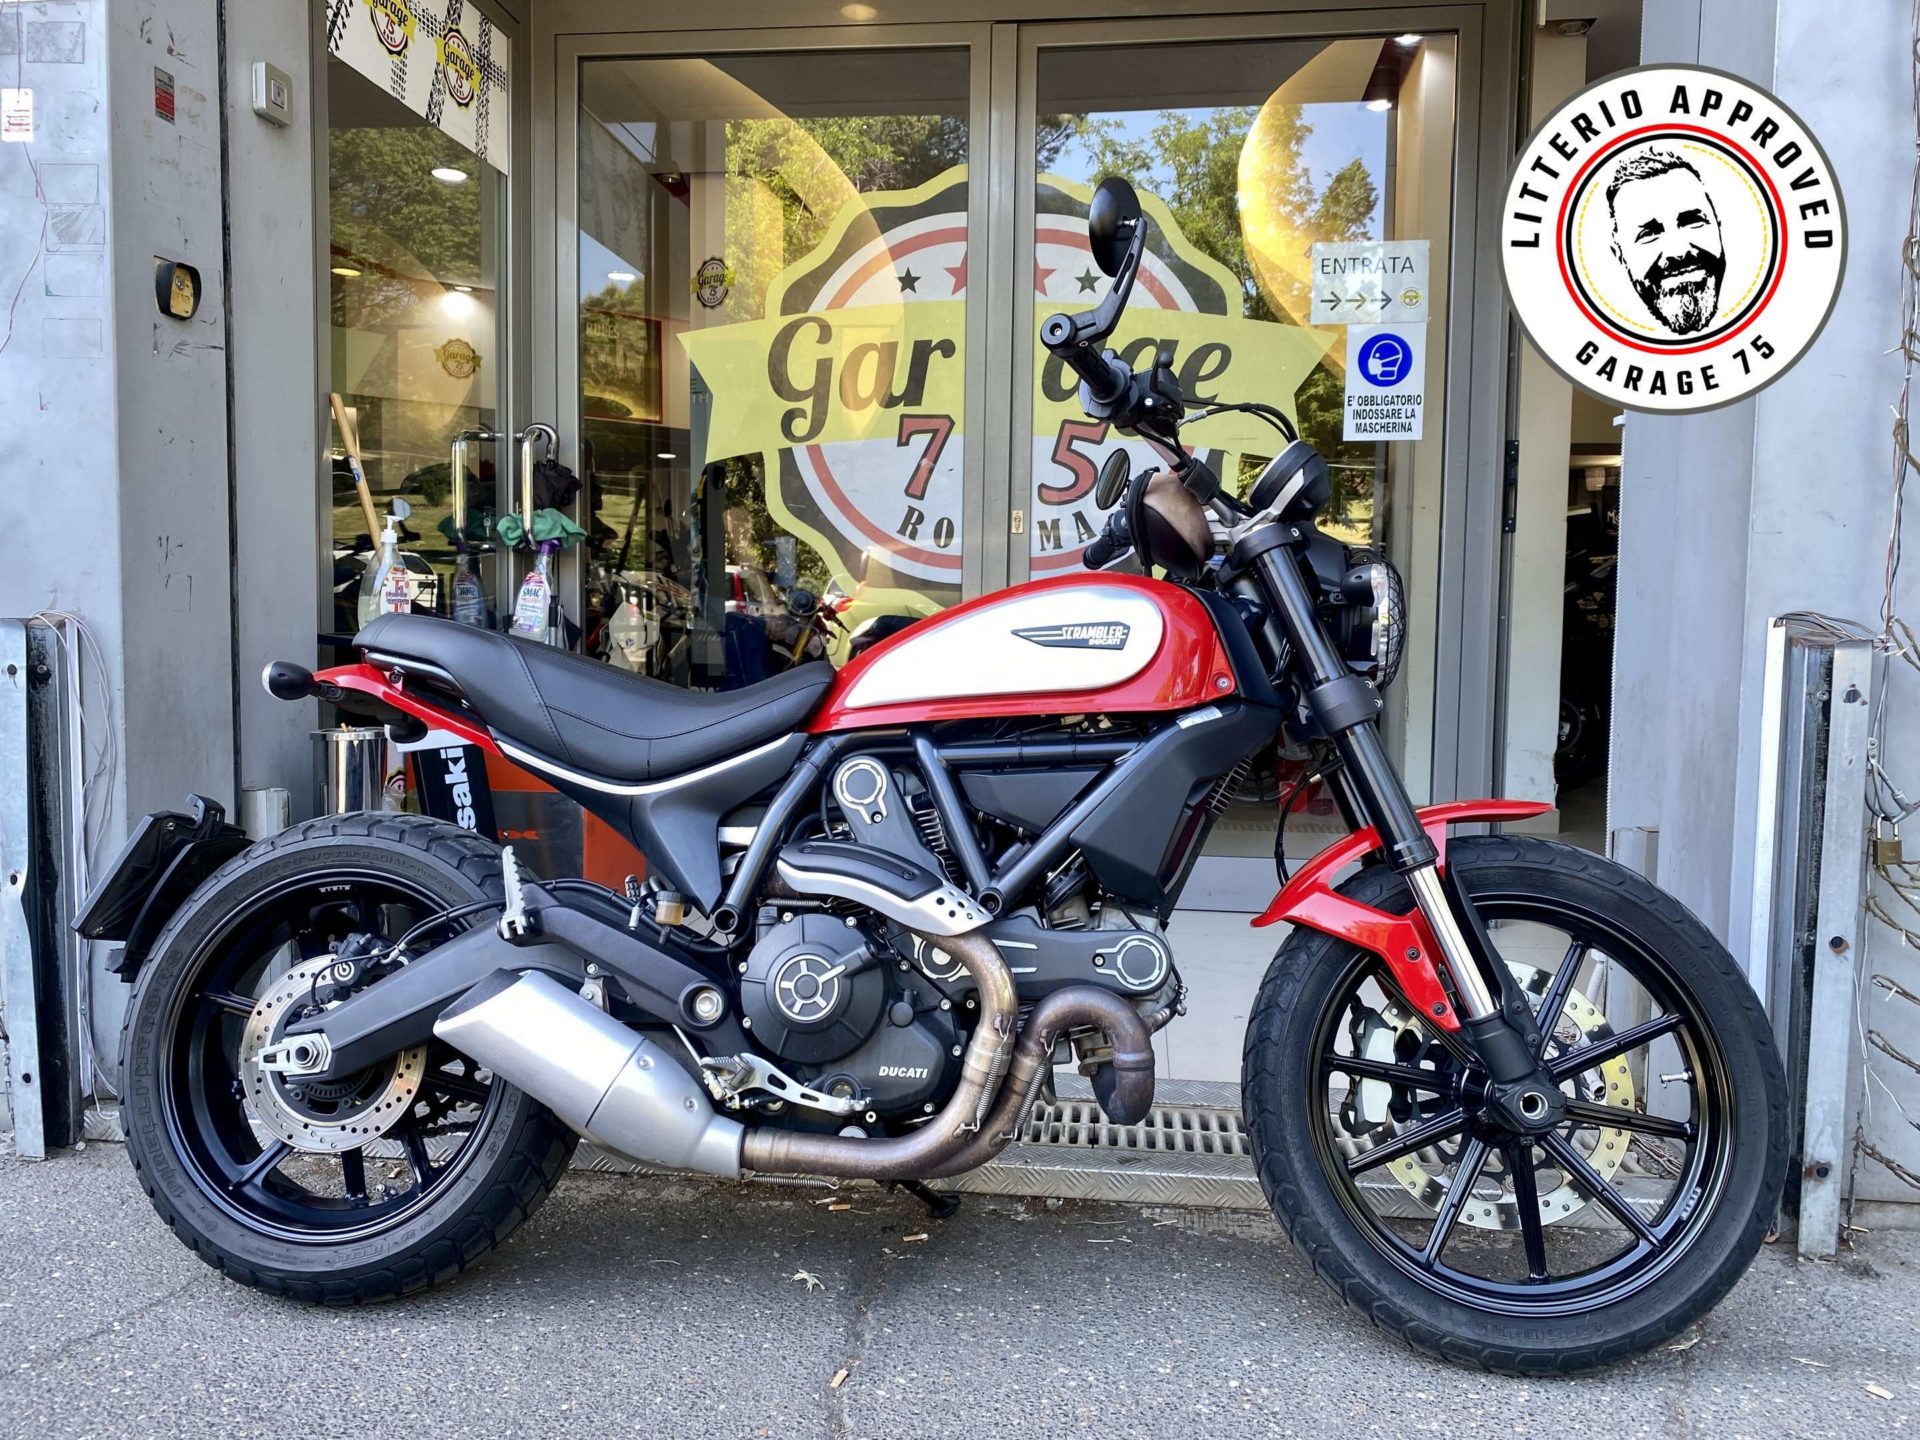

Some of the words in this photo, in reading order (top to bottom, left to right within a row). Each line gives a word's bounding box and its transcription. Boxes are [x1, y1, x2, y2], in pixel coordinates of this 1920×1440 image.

[443, 41, 475, 81] Garage
[1320, 256, 1415, 275] ENTRATA
[1347, 395, 1356, 407] E'
[1357, 394, 1423, 407] OBBLIGATORIO
[1352, 408, 1403, 420] INDOSSARE
[1405, 408, 1416, 420] LA
[1355, 421, 1413, 434] MASCHERINA
[522, 587, 542, 598] SMAC
[1061, 625, 1124, 640] SCRAMBLER
[879, 1065, 929, 1079] DUCATI
